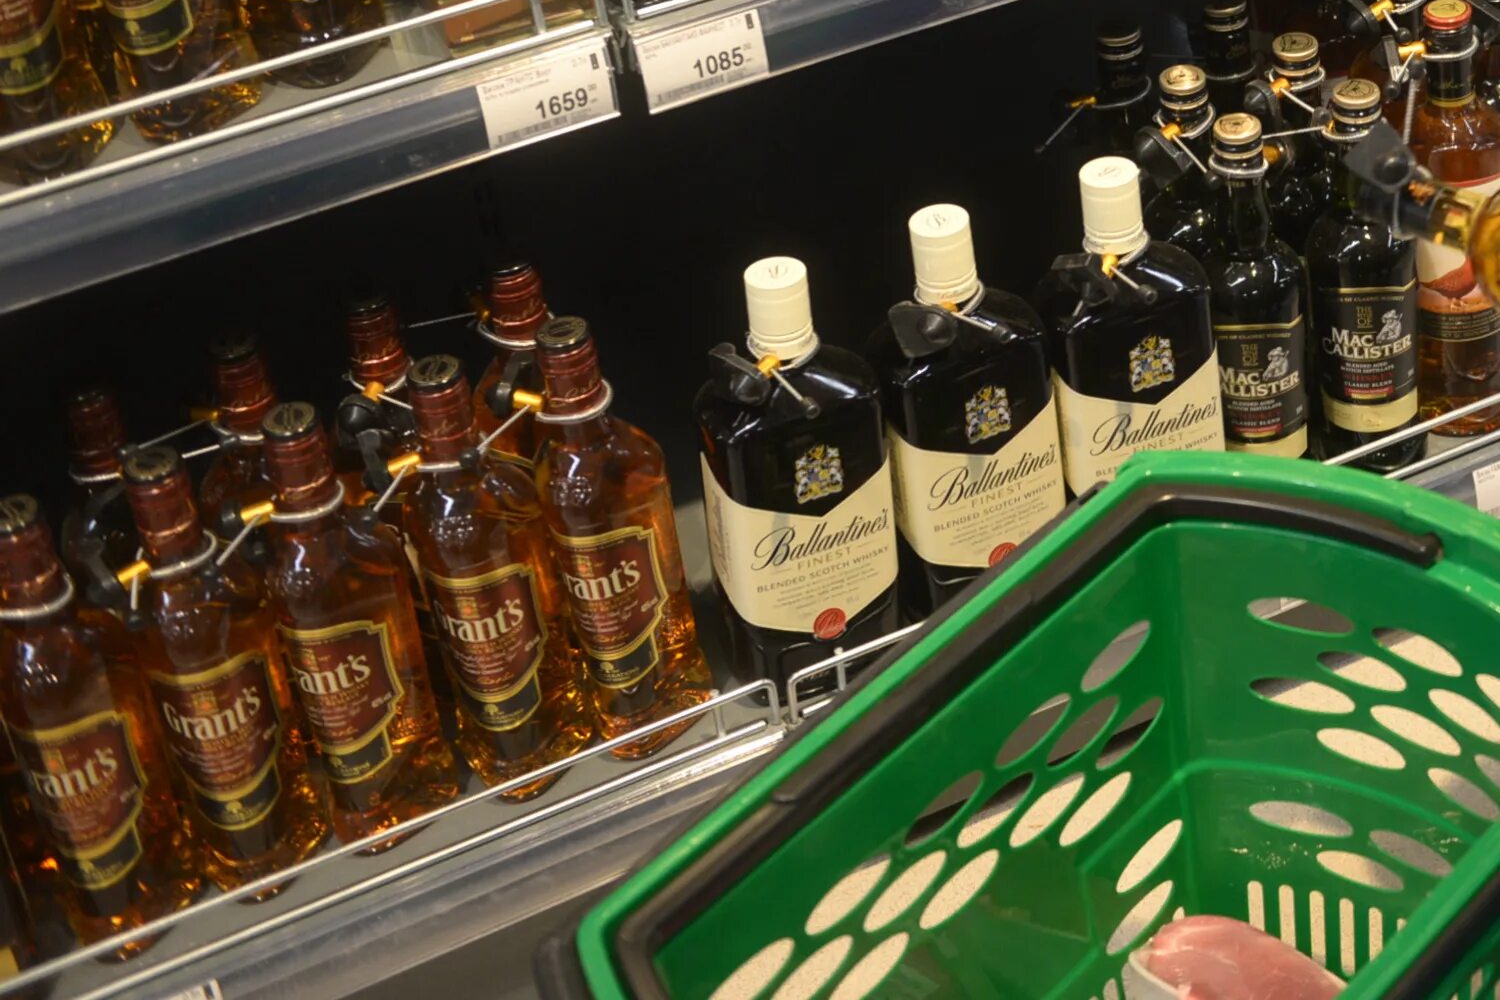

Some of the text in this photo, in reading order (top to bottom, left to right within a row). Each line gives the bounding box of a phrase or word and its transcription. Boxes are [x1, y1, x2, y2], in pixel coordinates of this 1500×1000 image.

[693, 46, 744, 79] 1085
[535, 87, 588, 119] 1659
[1322, 333, 1413, 359] CALLISTER
[1331, 326, 1374, 347] MAC
[1218, 365, 1260, 386] MAC
[1220, 370, 1300, 397] ALLISTER
[1090, 396, 1218, 457] Ballantine's
[926, 443, 1057, 512] Ballantine's
[971, 482, 1022, 508] FINEST
[933, 479, 1057, 533] BLENDED SCOTCH WHISKY
[751, 508, 889, 571] Ballantine's
[797, 546, 851, 570] FINEST
[563, 559, 641, 601] rant's
[756, 573, 806, 593] BLENDED
[809, 560, 851, 579] SCOTCH
[852, 545, 890, 566] WHISKY
[298, 654, 371, 695] ant's
[163, 686, 261, 740] Grant's
[31, 747, 118, 799] rant's
